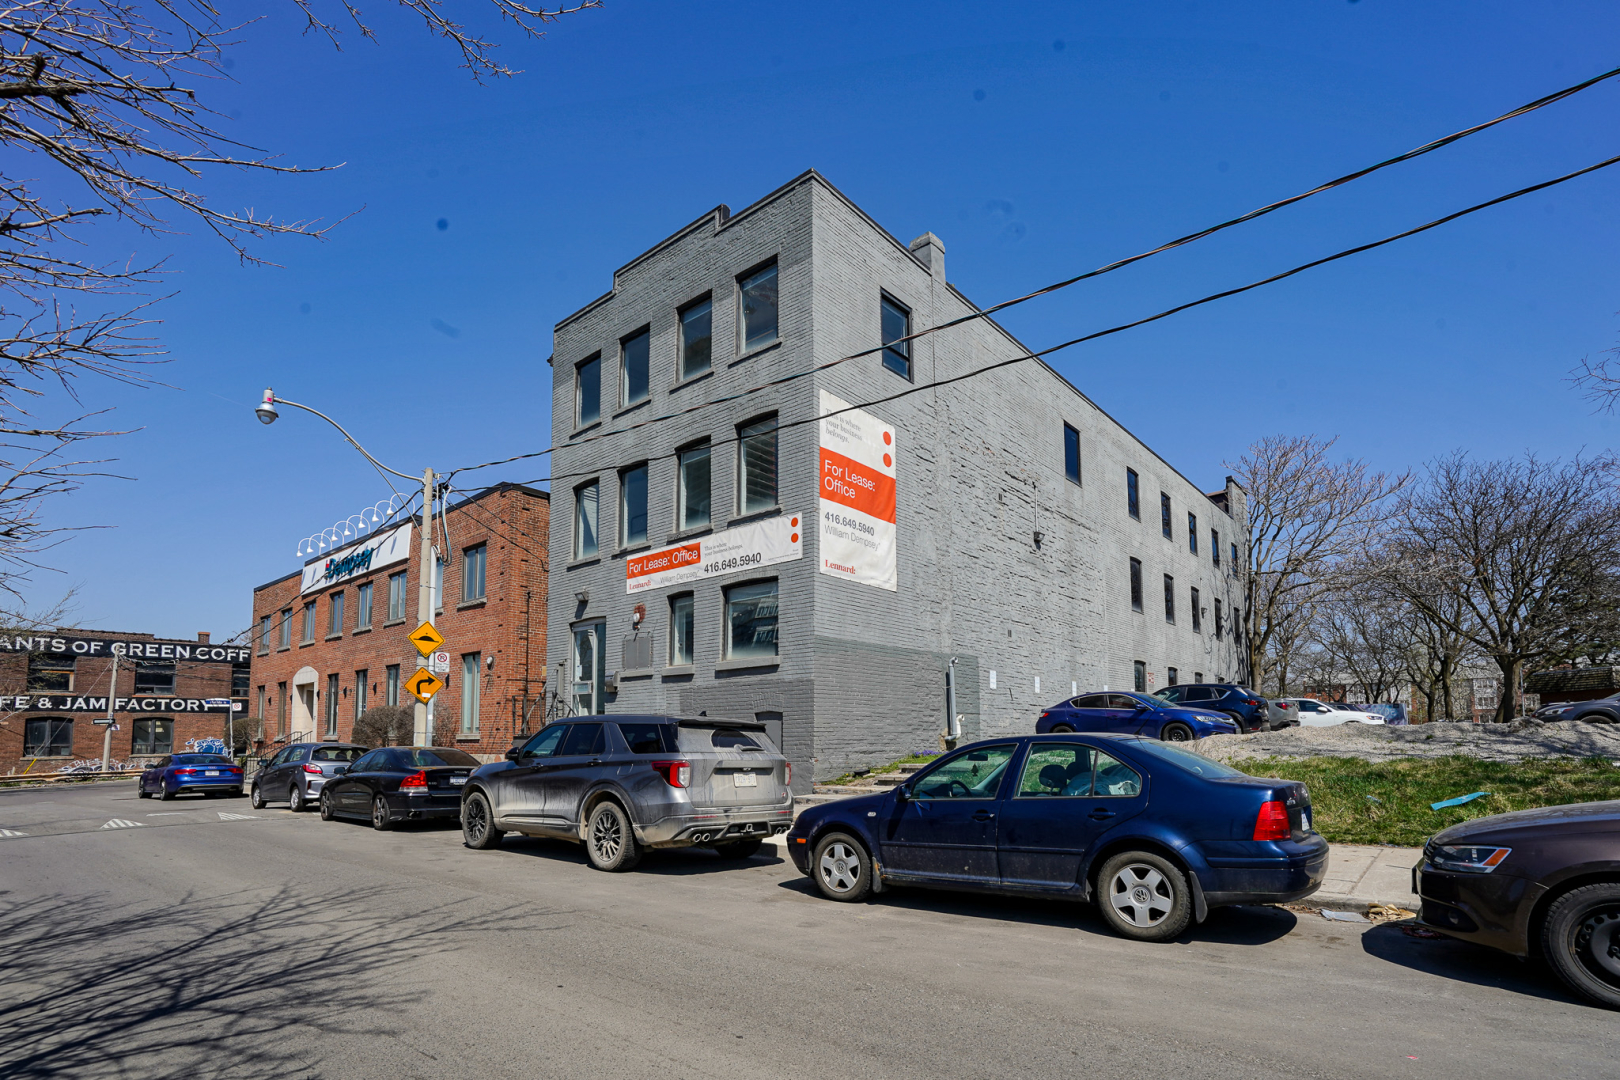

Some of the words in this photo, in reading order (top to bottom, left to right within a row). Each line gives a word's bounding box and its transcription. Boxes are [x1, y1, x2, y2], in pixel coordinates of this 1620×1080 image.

[825, 419, 839, 430] your
[840, 423, 863, 441] business
[845, 419, 861, 432] where
[824, 459, 843, 477] For
[845, 467, 876, 492] Lease:
[824, 476, 856, 499] Office
[824, 511, 875, 537] 416.649.5940
[824, 524, 850, 540] William
[325, 547, 375, 578] Dempsey
[629, 562, 643, 574] For
[643, 556, 670, 571] Lease:
[672, 549, 699, 564] Office
[703, 552, 762, 574] 416.649.5940
[825, 559, 856, 575] Lennard:
[71, 641, 104, 654] OF
[110, 642, 191, 659] GREEN
[195, 647, 251, 662] COFF
[37, 697, 53, 709] &
[59, 697, 107, 710] JAM
[114, 698, 209, 711] FACTORY
